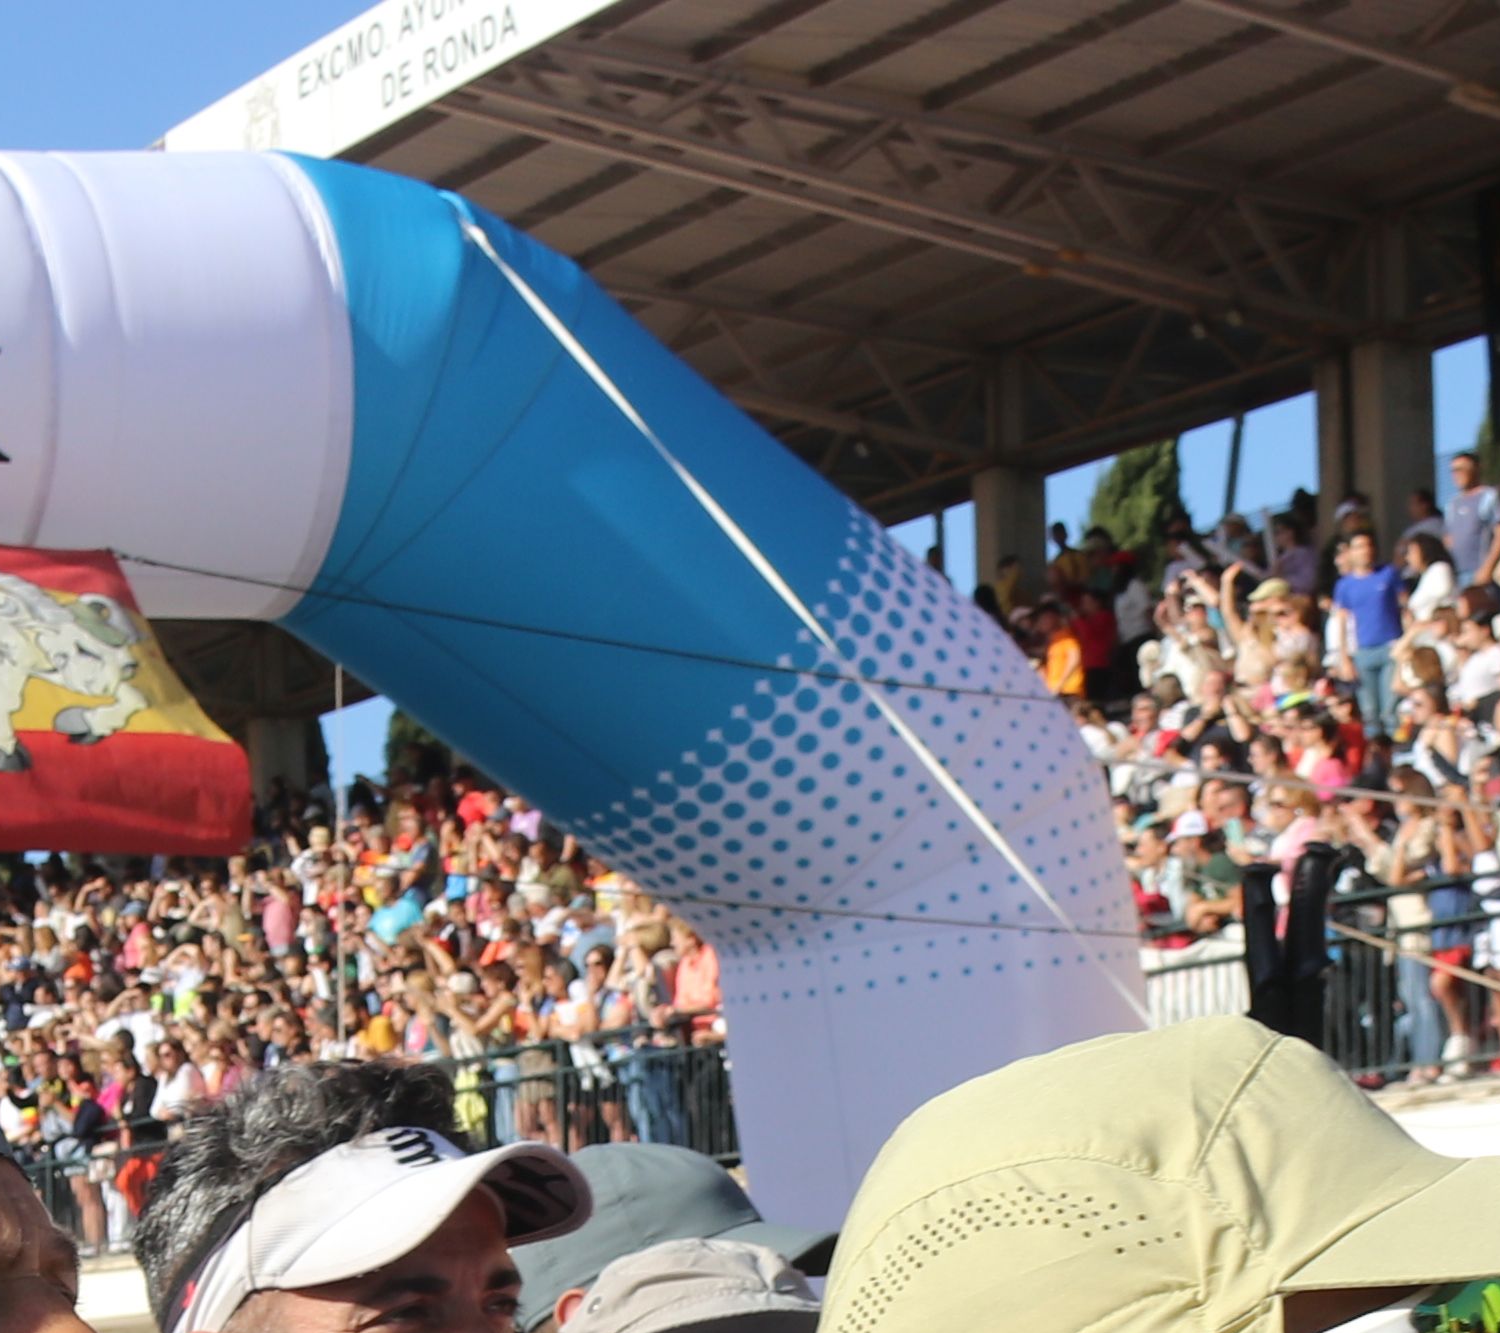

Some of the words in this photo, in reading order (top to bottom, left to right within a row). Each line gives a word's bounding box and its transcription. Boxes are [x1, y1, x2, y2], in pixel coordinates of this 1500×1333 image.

[298, 22, 390, 100] EXCMO.
[399, 0, 466, 40] AYU
[382, 61, 414, 109] DE
[422, 5, 518, 85] RONDA
